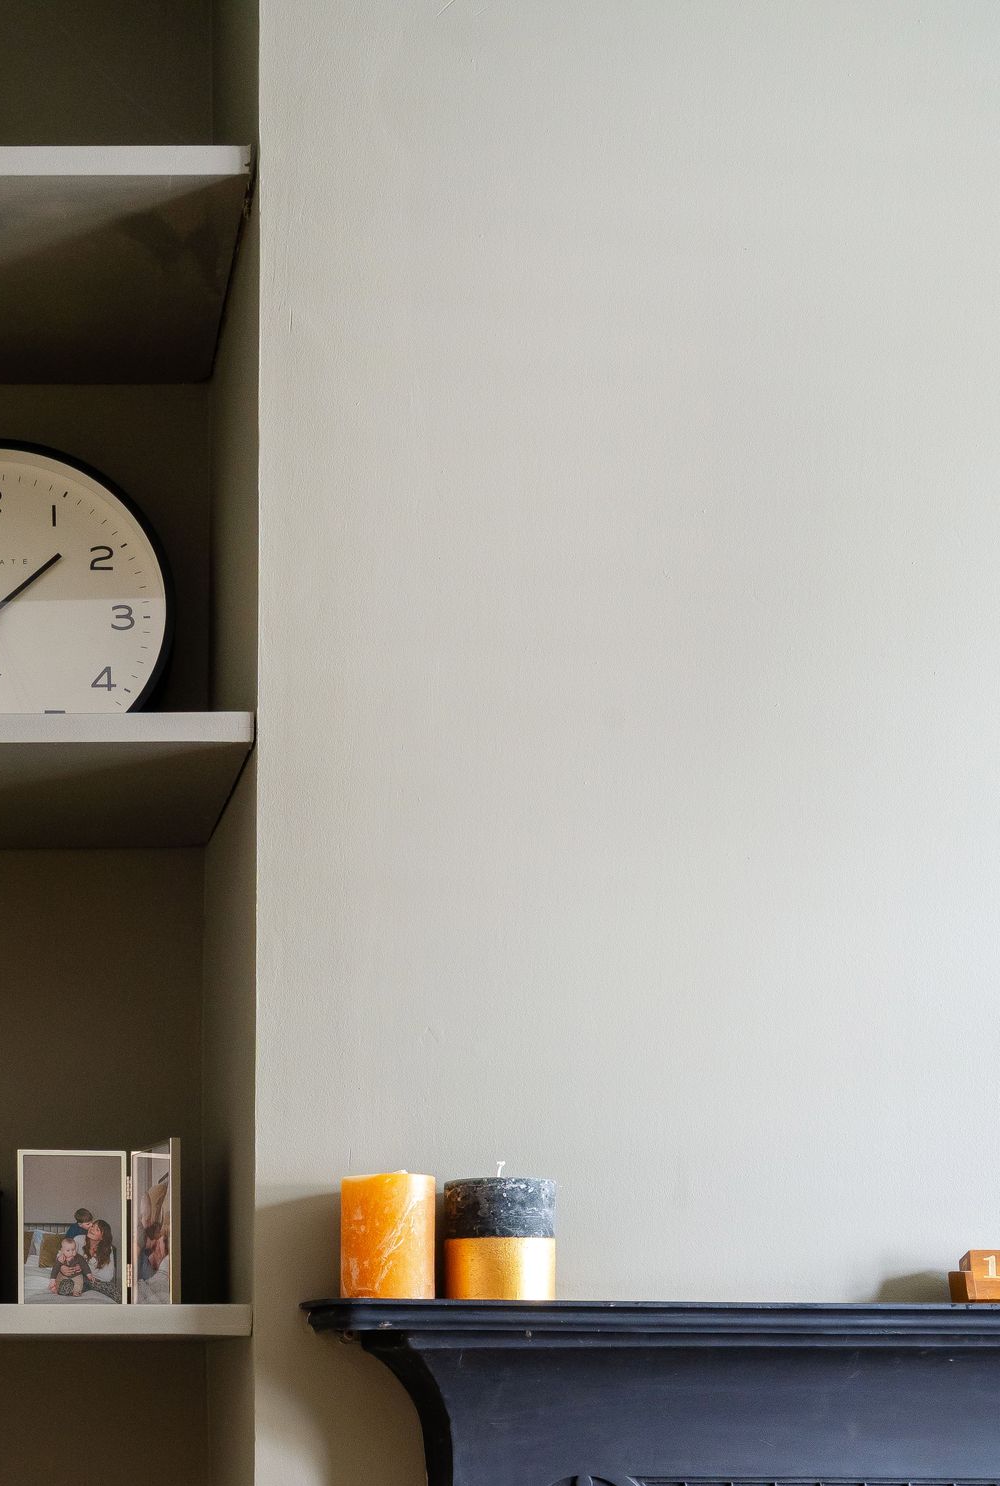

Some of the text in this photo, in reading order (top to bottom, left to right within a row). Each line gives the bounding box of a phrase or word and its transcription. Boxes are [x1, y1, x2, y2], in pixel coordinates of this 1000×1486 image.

[51, 504, 57, 527] 1
[89, 545, 114, 571] 2
[110, 604, 136, 631] 3
[90, 665, 117, 692] 4
[983, 1254, 1000, 1279] 1
